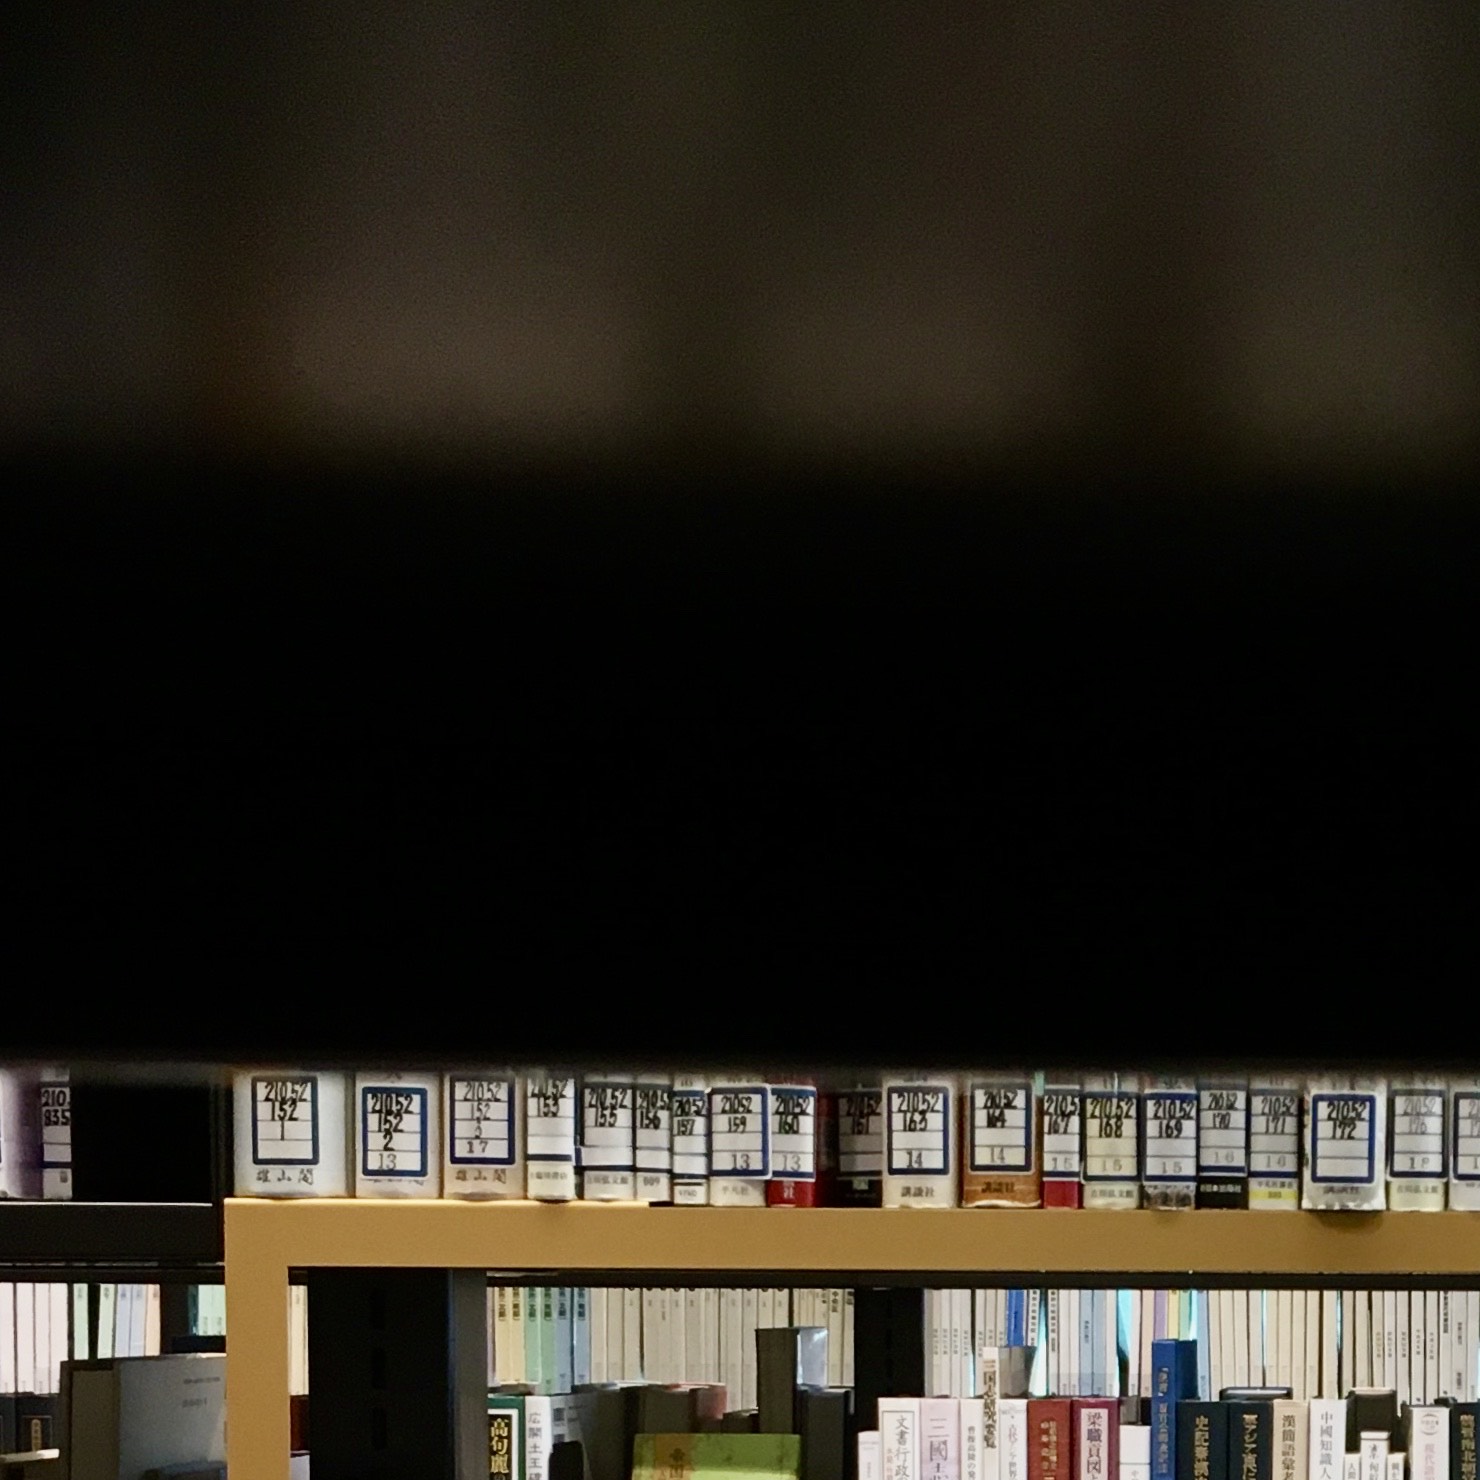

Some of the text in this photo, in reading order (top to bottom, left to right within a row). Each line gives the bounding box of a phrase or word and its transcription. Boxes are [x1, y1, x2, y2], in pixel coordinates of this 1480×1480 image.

[270, 1100, 300, 1121] 152
[377, 1113, 405, 1133] 152
[1158, 1118, 1183, 1138] 169
[377, 1152, 398, 1171] 13
